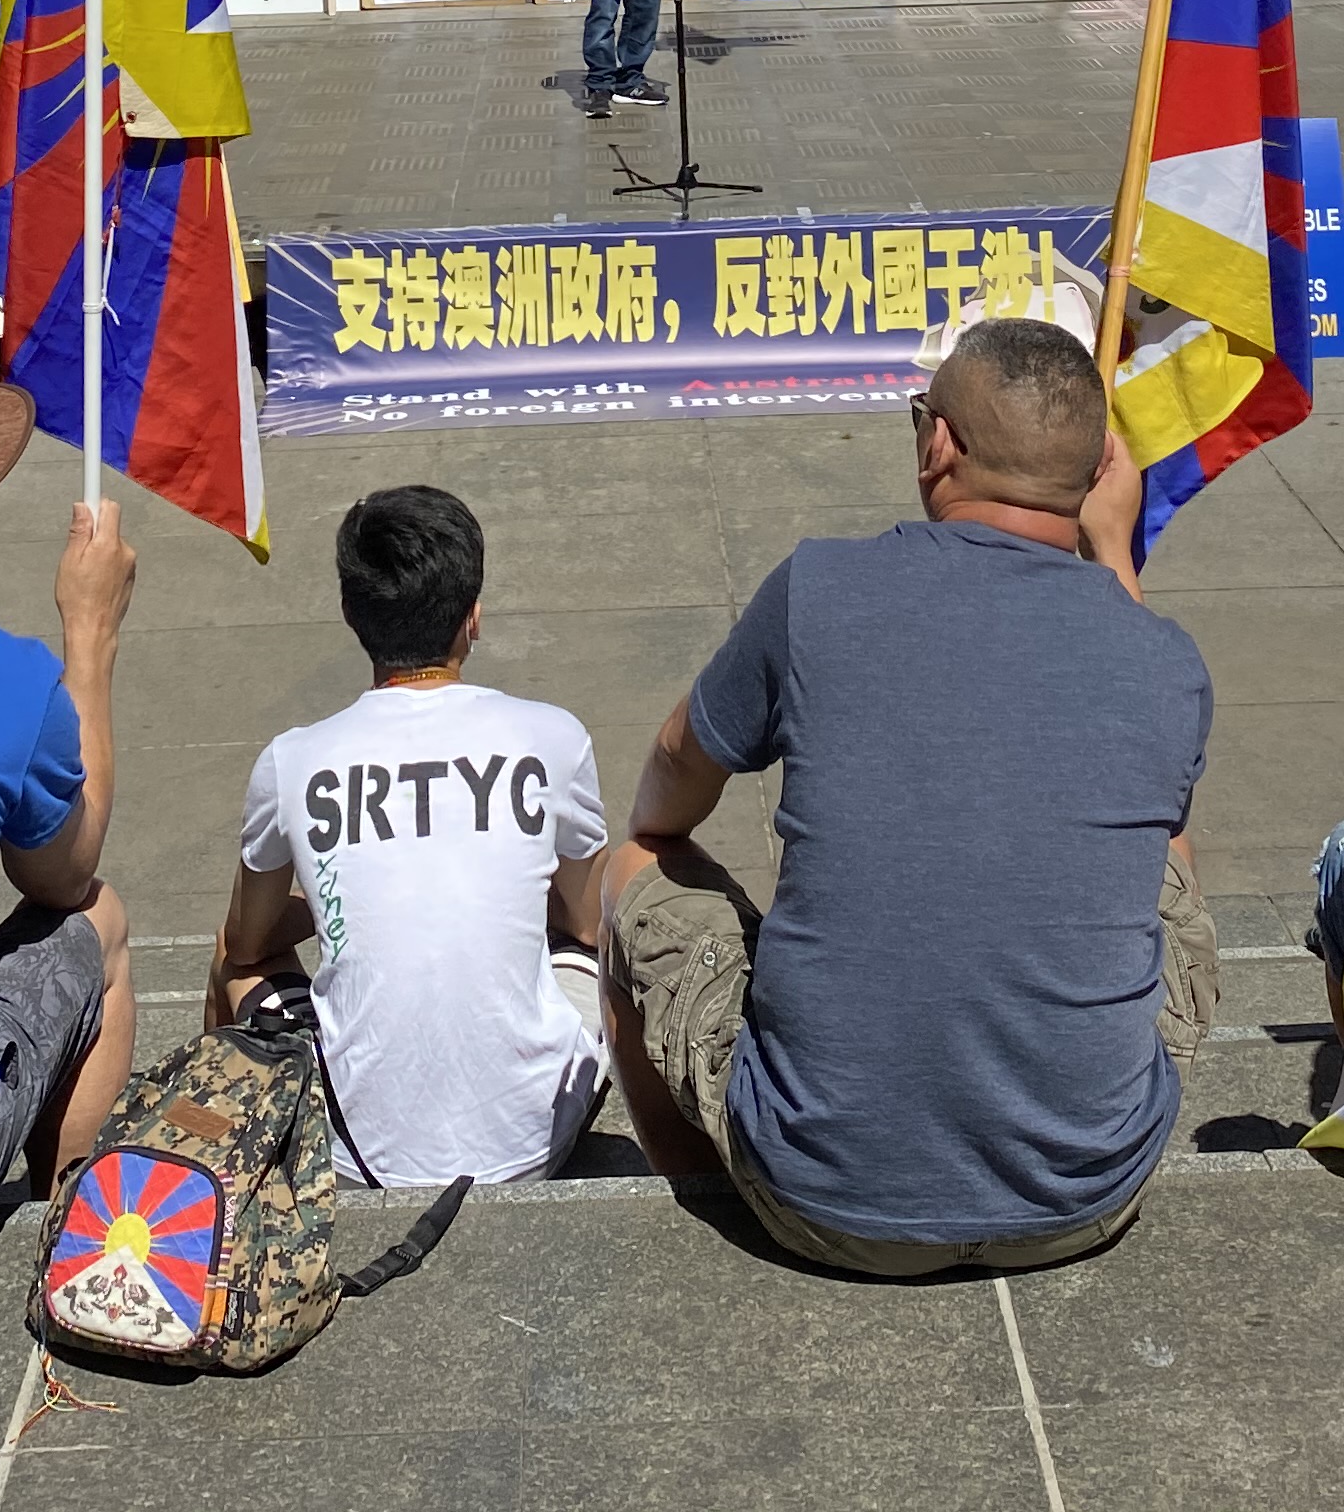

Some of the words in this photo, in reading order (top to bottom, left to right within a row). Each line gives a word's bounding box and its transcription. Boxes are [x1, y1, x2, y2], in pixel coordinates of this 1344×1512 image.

[343, 387, 492, 407] Stand
[524, 382, 648, 397] with
[682, 372, 928, 391] Australia
[341, 408, 408, 423] No
[439, 399, 636, 419] foreign
[305, 753, 548, 854] SRTYC
